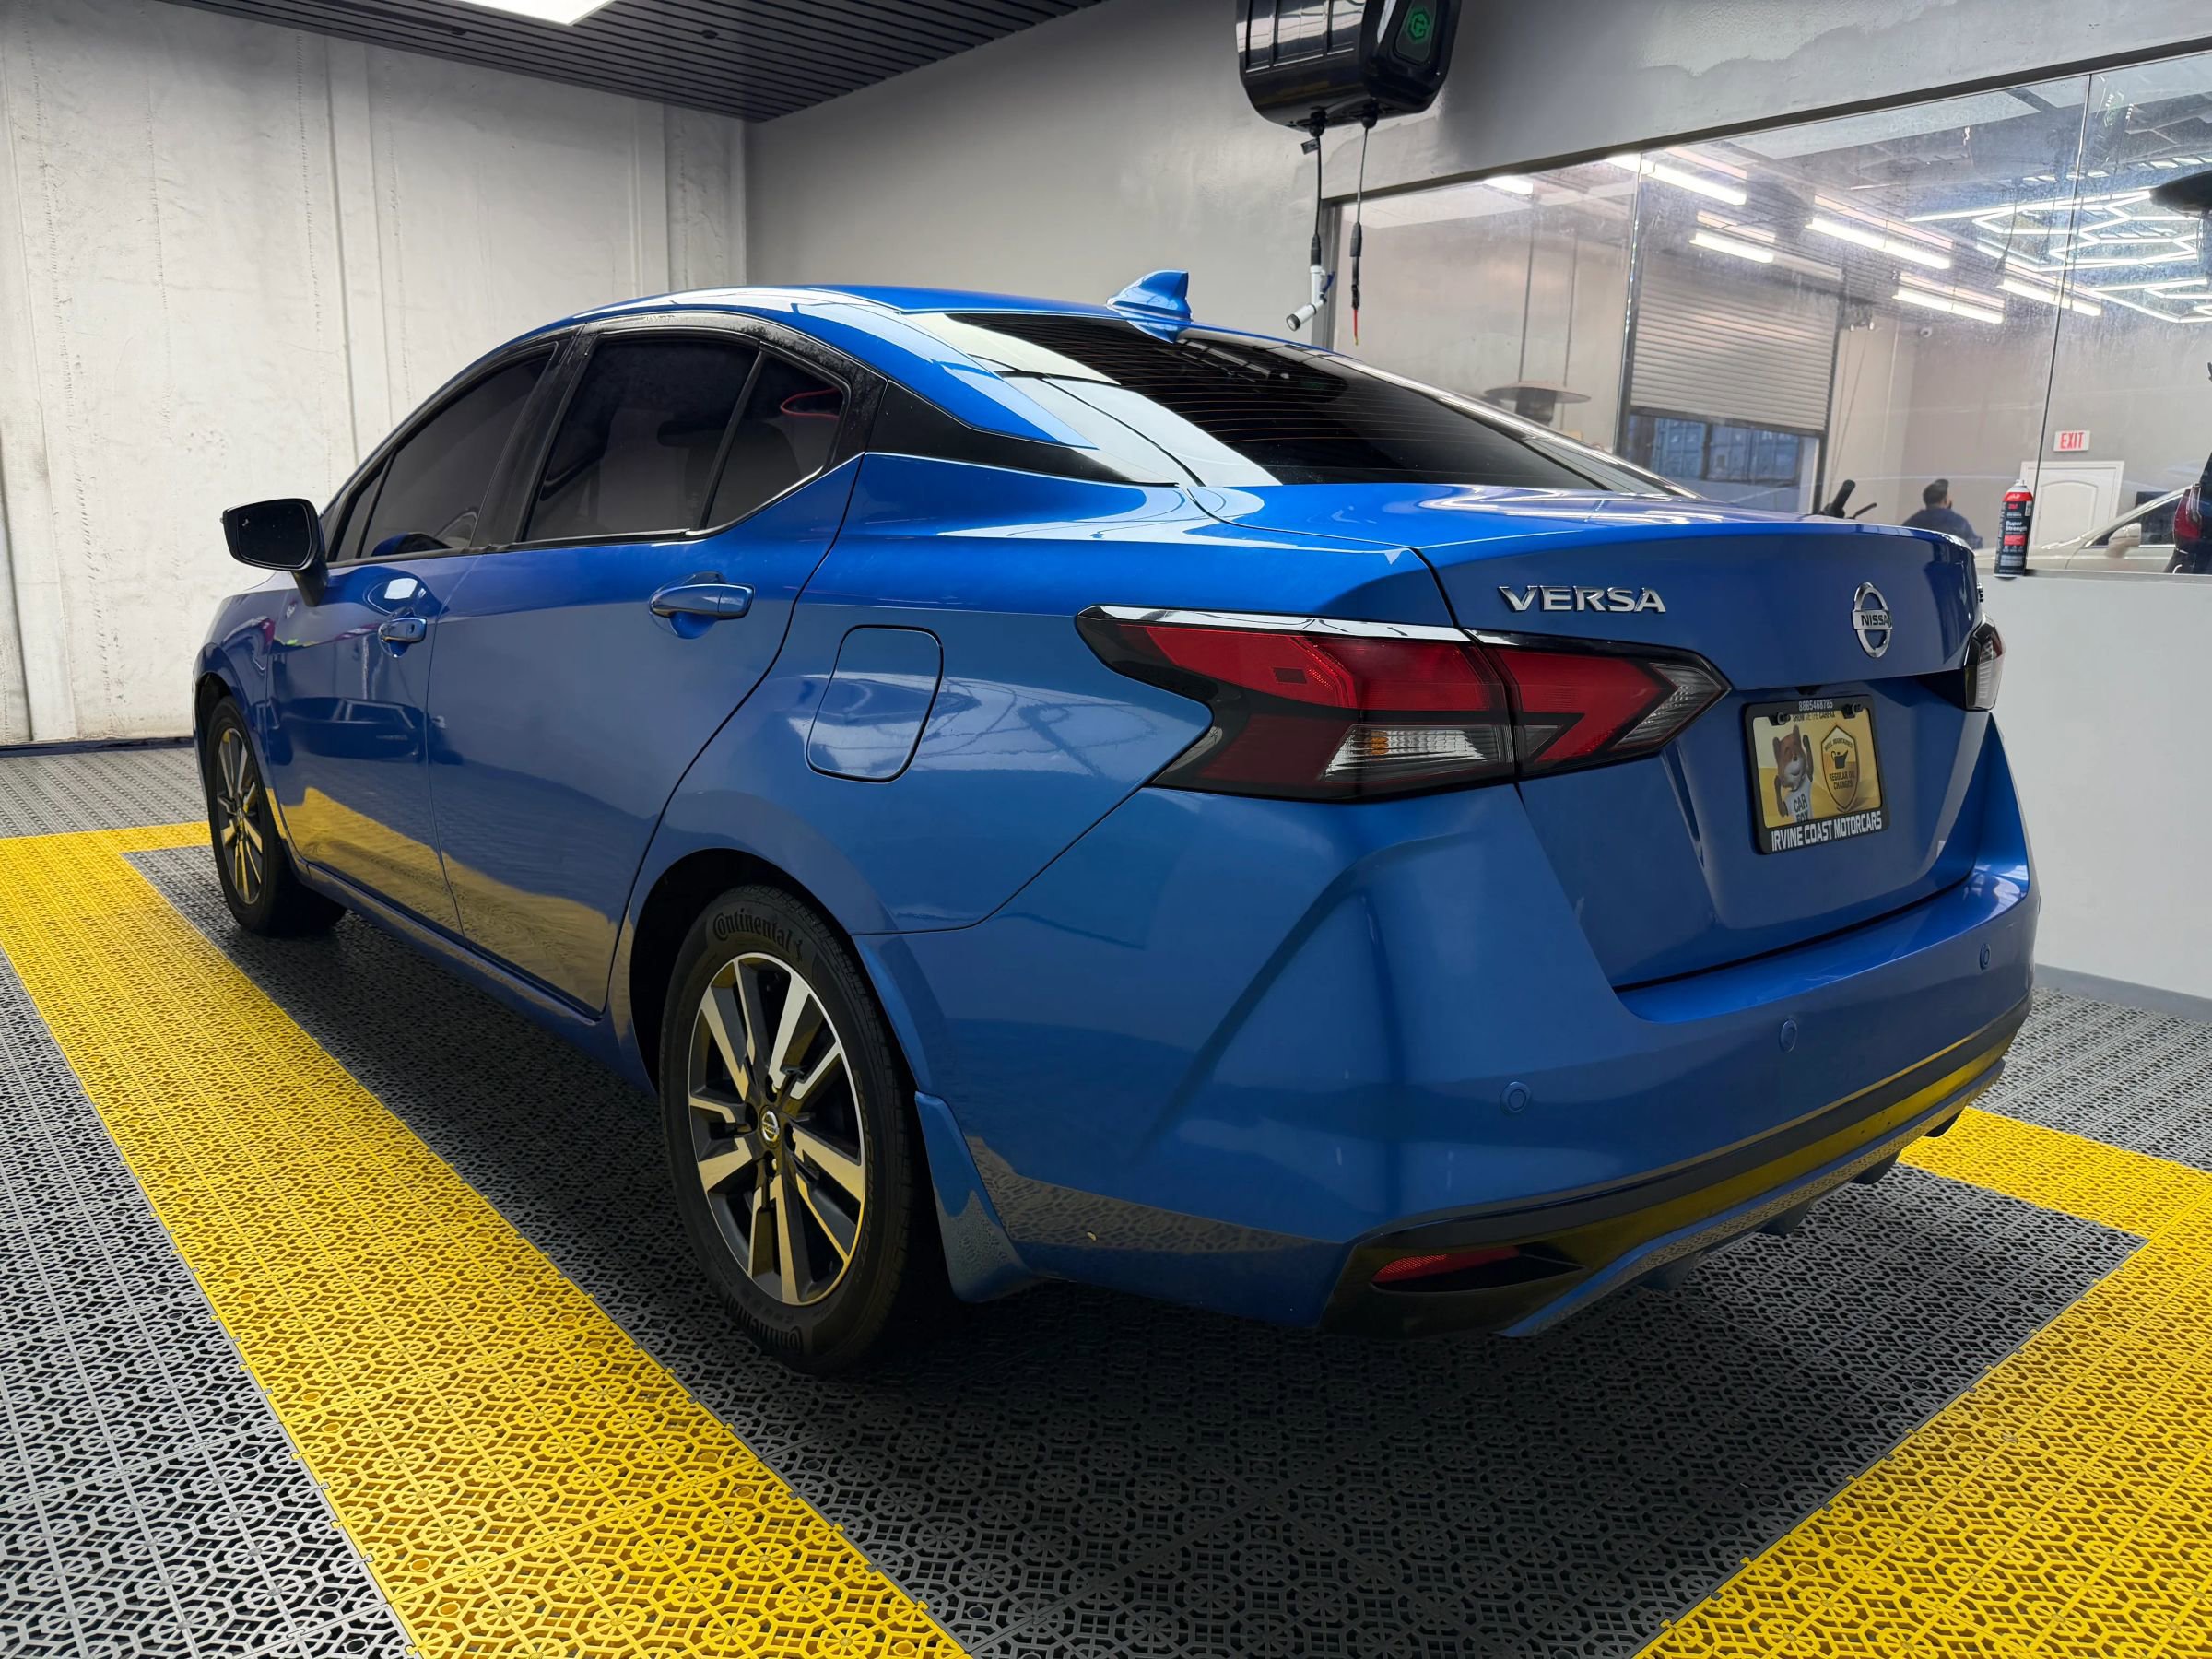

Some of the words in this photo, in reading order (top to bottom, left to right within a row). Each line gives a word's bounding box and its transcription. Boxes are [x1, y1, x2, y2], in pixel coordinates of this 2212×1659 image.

[2060, 432, 2085, 450] EXIT
[1498, 585, 1666, 613] VERSA
[1794, 793, 1808, 813] CAR
[1771, 825, 1804, 852] IRVINE
[1804, 819, 1833, 845] COAST
[1834, 810, 1882, 839] MOTORCARS
[712, 908, 794, 954] Continental
